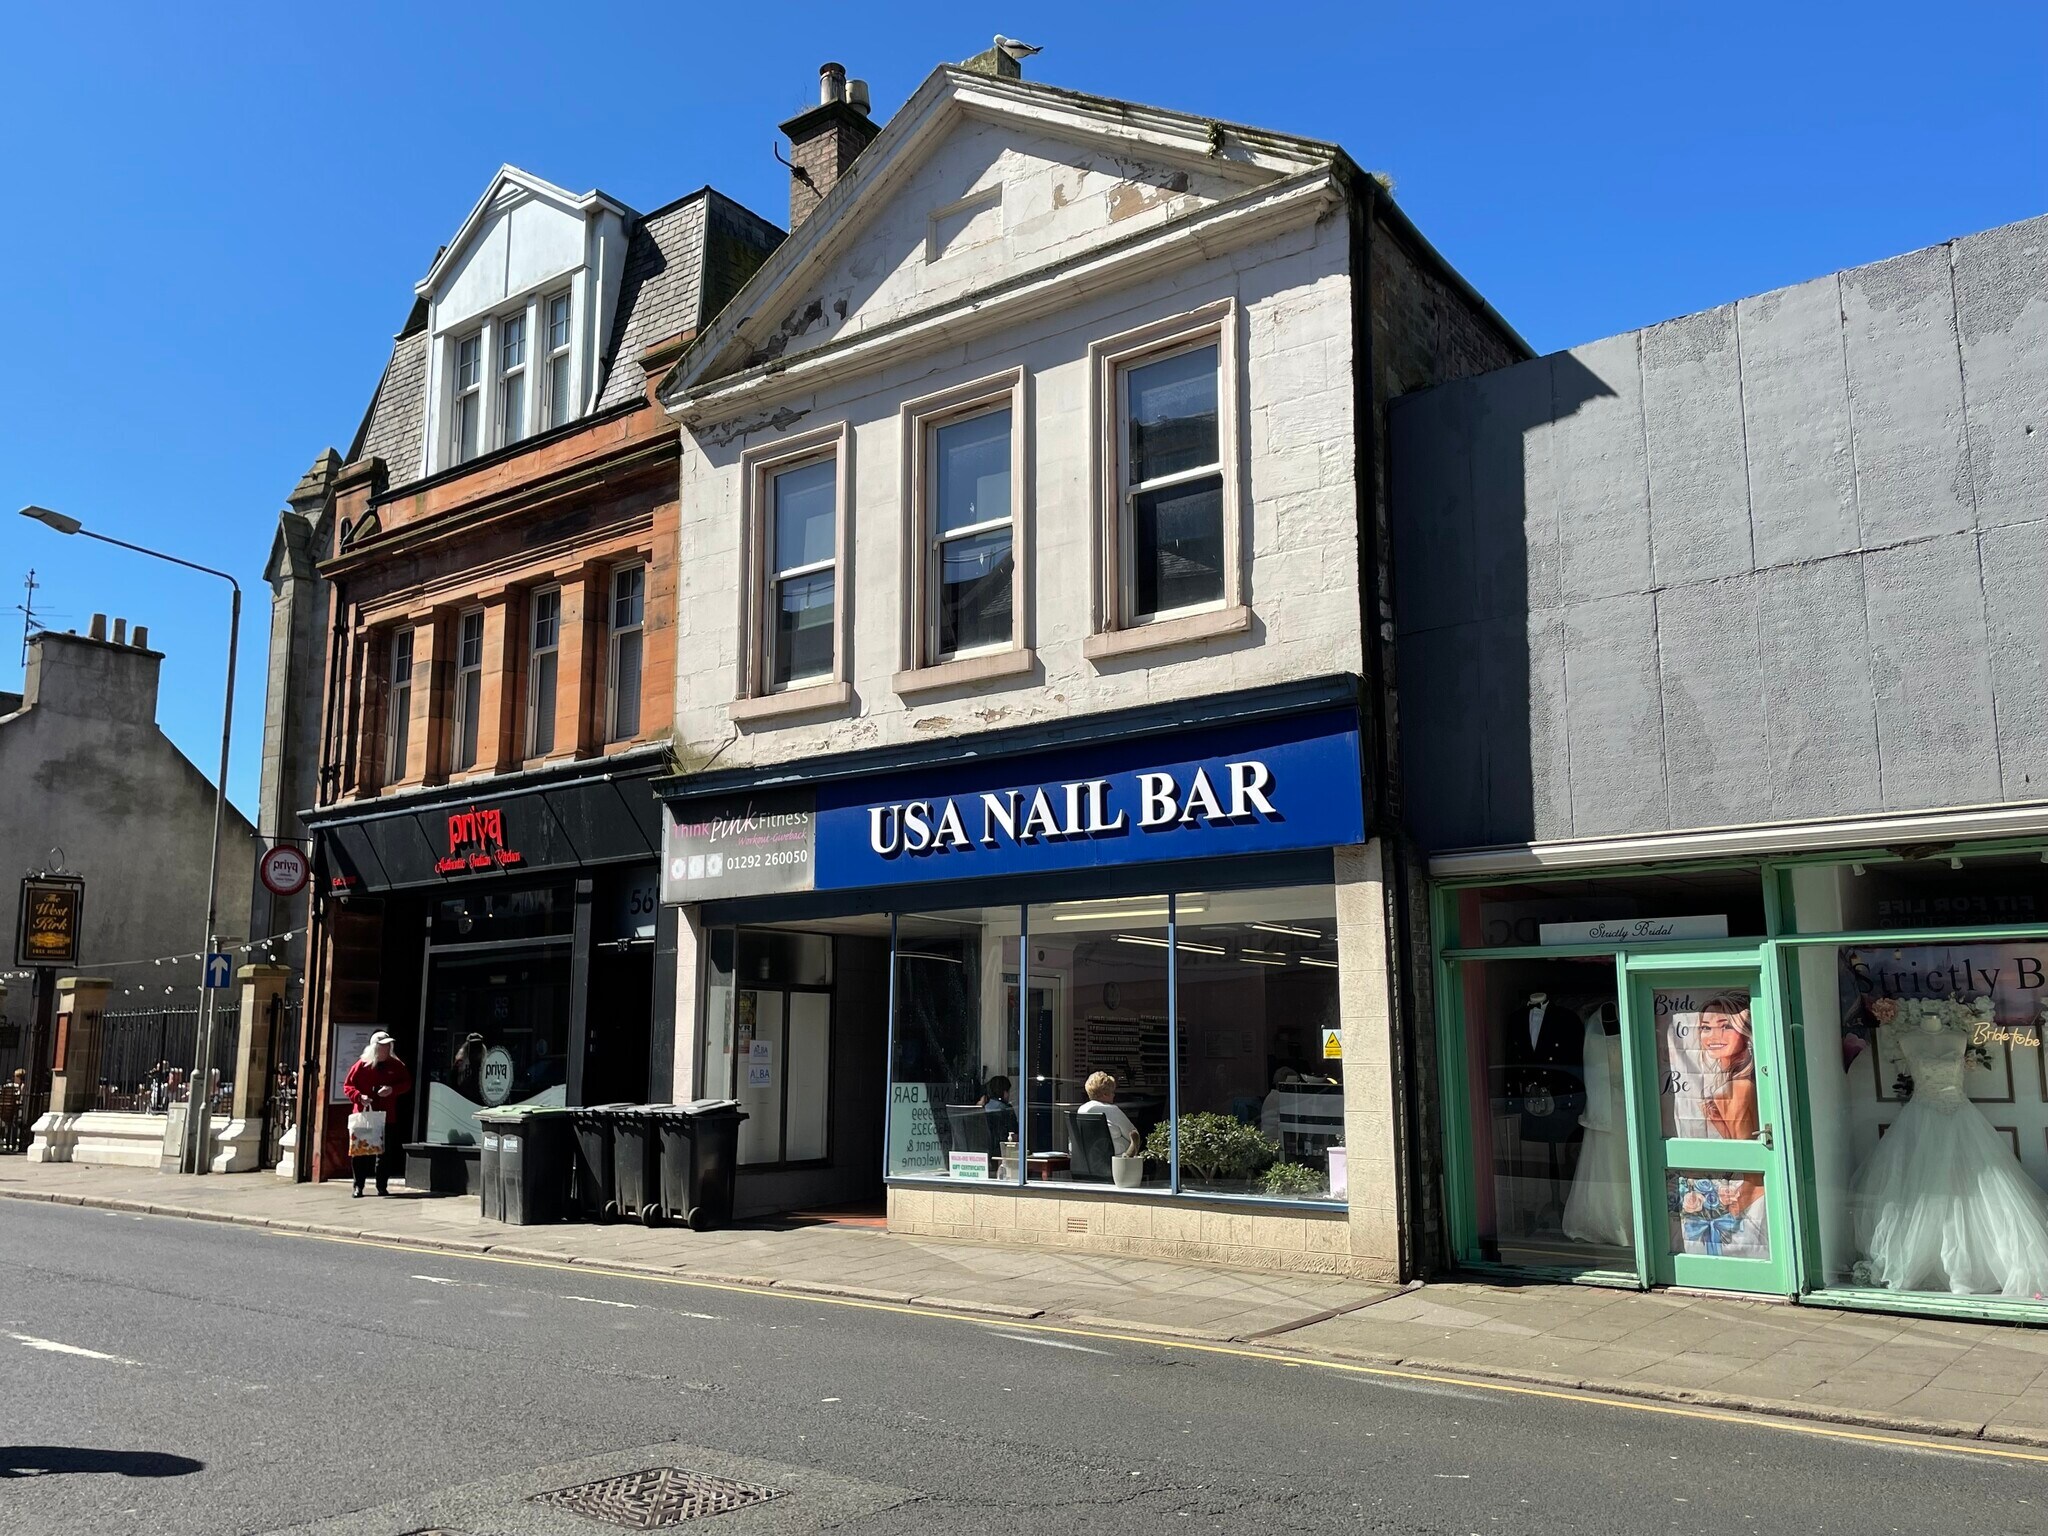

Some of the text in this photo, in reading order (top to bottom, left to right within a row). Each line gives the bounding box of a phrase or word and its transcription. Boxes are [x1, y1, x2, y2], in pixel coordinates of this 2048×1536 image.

[867, 760, 1277, 854] USA NAIL BAR
[448, 805, 503, 854] priya
[672, 820, 710, 839] Think
[759, 811, 809, 829] Fitness
[273, 860, 298, 875] priya
[727, 850, 808, 870] 01292 260050
[36, 903, 68, 917] West
[33, 917, 67, 931] Kirk
[1589, 921, 1674, 942] Strictly Bridal
[1853, 958, 2000, 998] Strictly
[1653, 994, 1699, 1016] Bride
[485, 1061, 507, 1080] priya
[1660, 1070, 1690, 1096] Be
